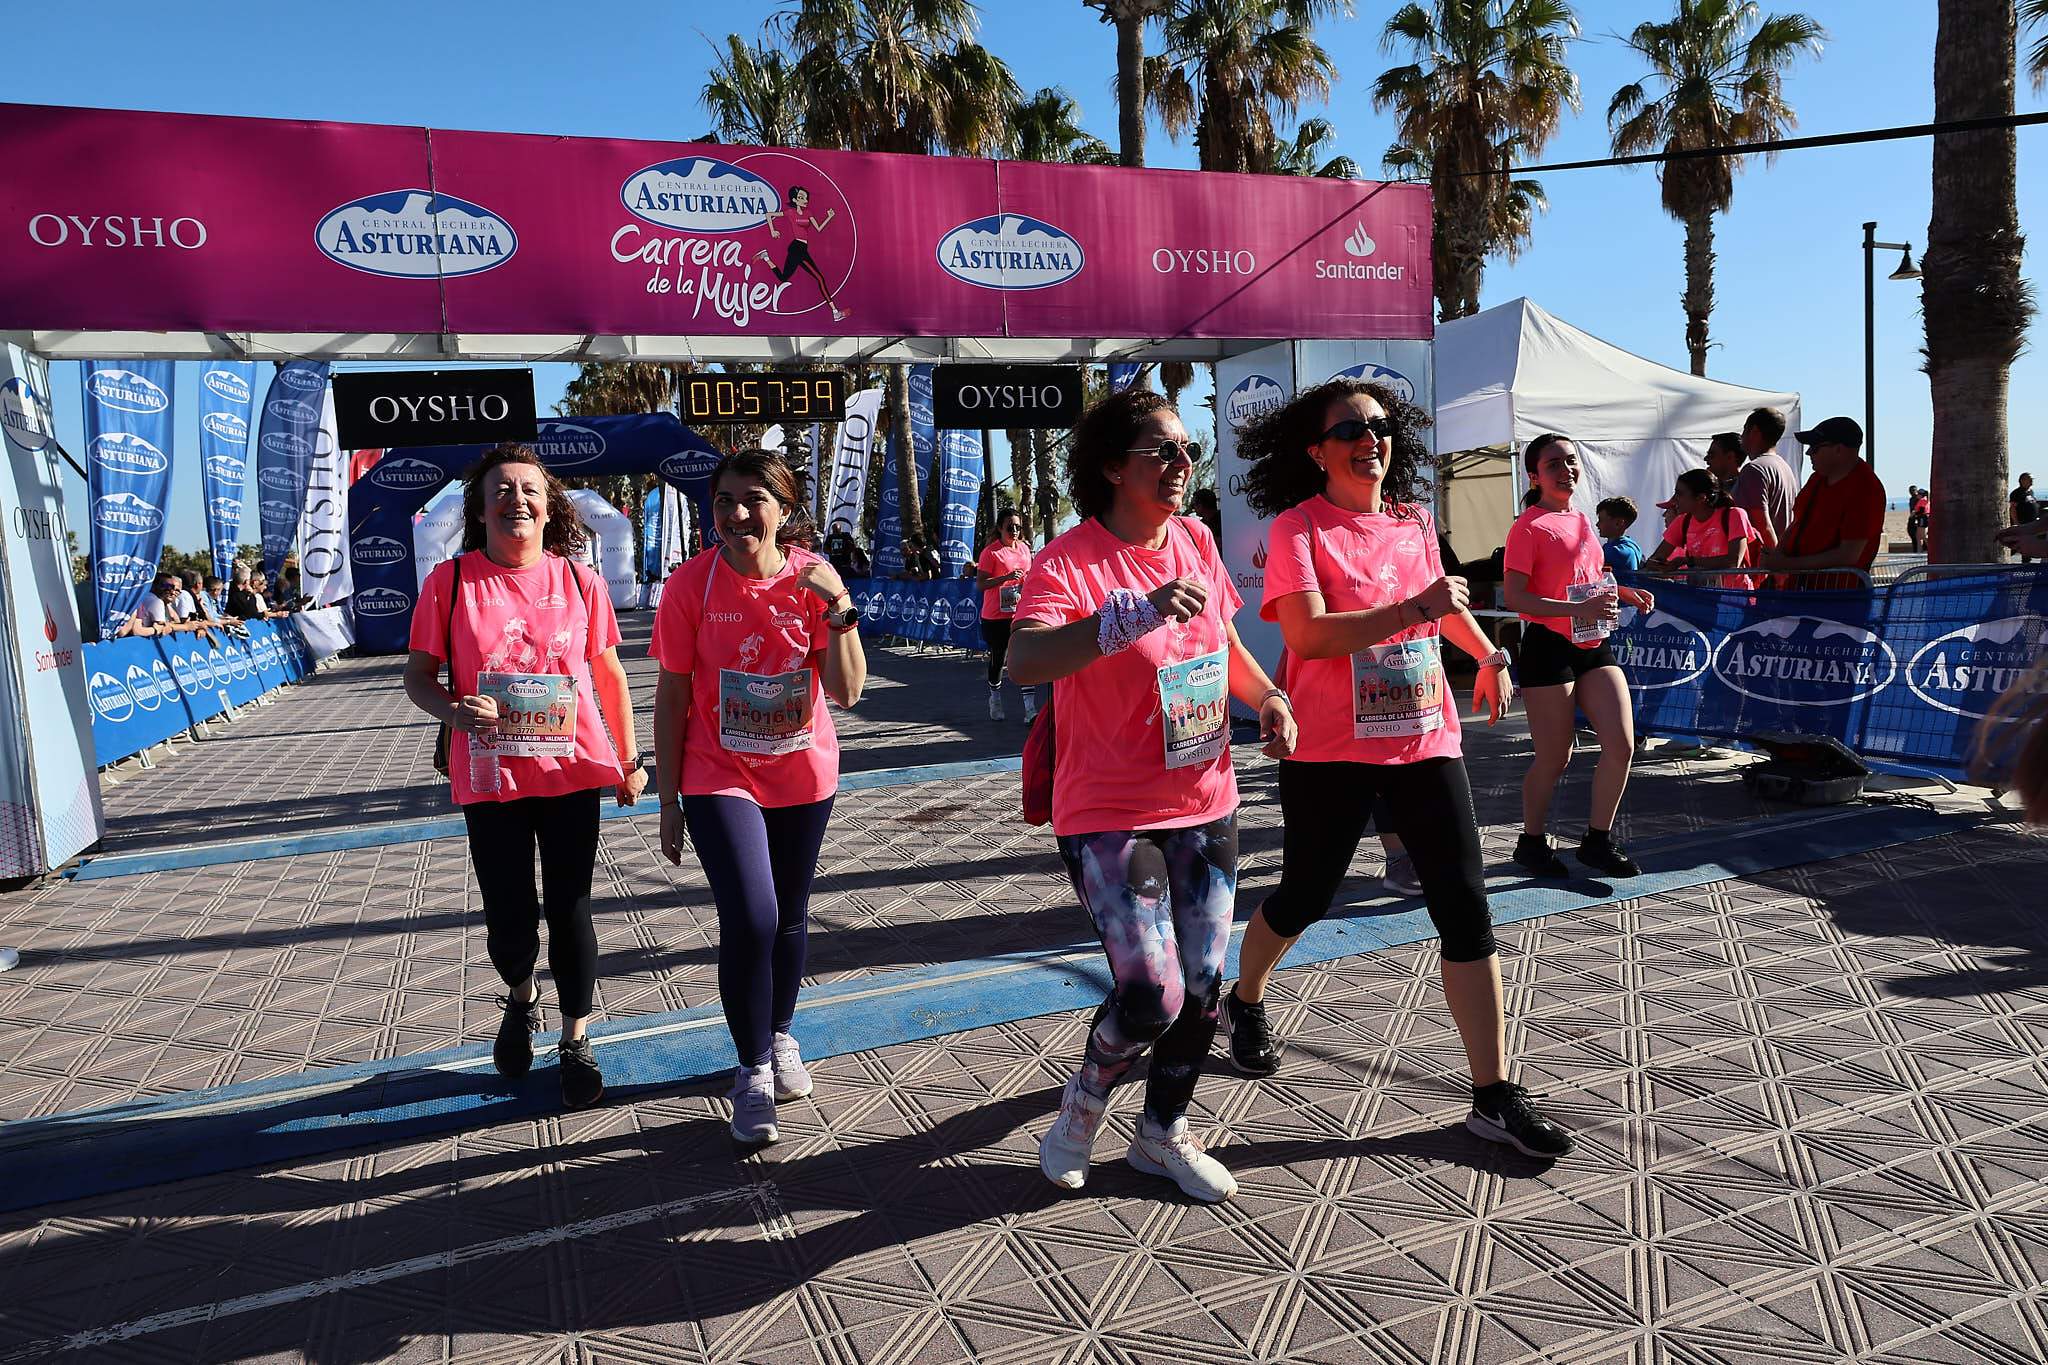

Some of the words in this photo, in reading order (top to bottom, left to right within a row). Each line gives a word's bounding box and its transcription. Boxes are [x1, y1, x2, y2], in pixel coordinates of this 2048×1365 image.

[635, 182, 768, 215] ASTURIANA
[658, 181, 708, 191] CENTRAL
[713, 183, 763, 194] LECHERA
[28, 213, 207, 249] OYSHO
[362, 219, 426, 229] CENTRAL
[333, 220, 503, 256] ASTURIANA
[611, 224, 744, 267] Carrera
[1022, 240, 1068, 249] LECHERA
[949, 240, 1073, 270] ASTURIANA
[1152, 248, 1255, 275] OYSHO
[1315, 260, 1404, 281] Santander
[646, 266, 671, 294] de
[676, 265, 694, 294] la
[692, 264, 792, 327] Mujer
[94, 378, 161, 407] ASTURIANA
[208, 376, 248, 399] ASTURIAN
[690, 380, 833, 416] 00:57:39
[958, 385, 1062, 409] OYSHO
[369, 394, 509, 424] OYSHO
[521, 441, 598, 456] STURIANA
[376, 470, 438, 484] ASTURIANA
[304, 428, 334, 579] OYSHO
[14, 506, 63, 542] OYSHO
[354, 548, 403, 558] ASTURIANA
[357, 597, 407, 609] ASTURIANA
[35, 649, 73, 672] Santander
[1723, 642, 1877, 686] ASTURIANA
[1389, 682, 1425, 701] 016
[509, 710, 546, 725] 016
[750, 709, 784, 725] 016
[1360, 714, 1387, 722] CARRERA
[1366, 724, 1401, 734] OYSHO
[1172, 739, 1198, 750] CARRERA
[1178, 747, 1211, 762] OYSHO
